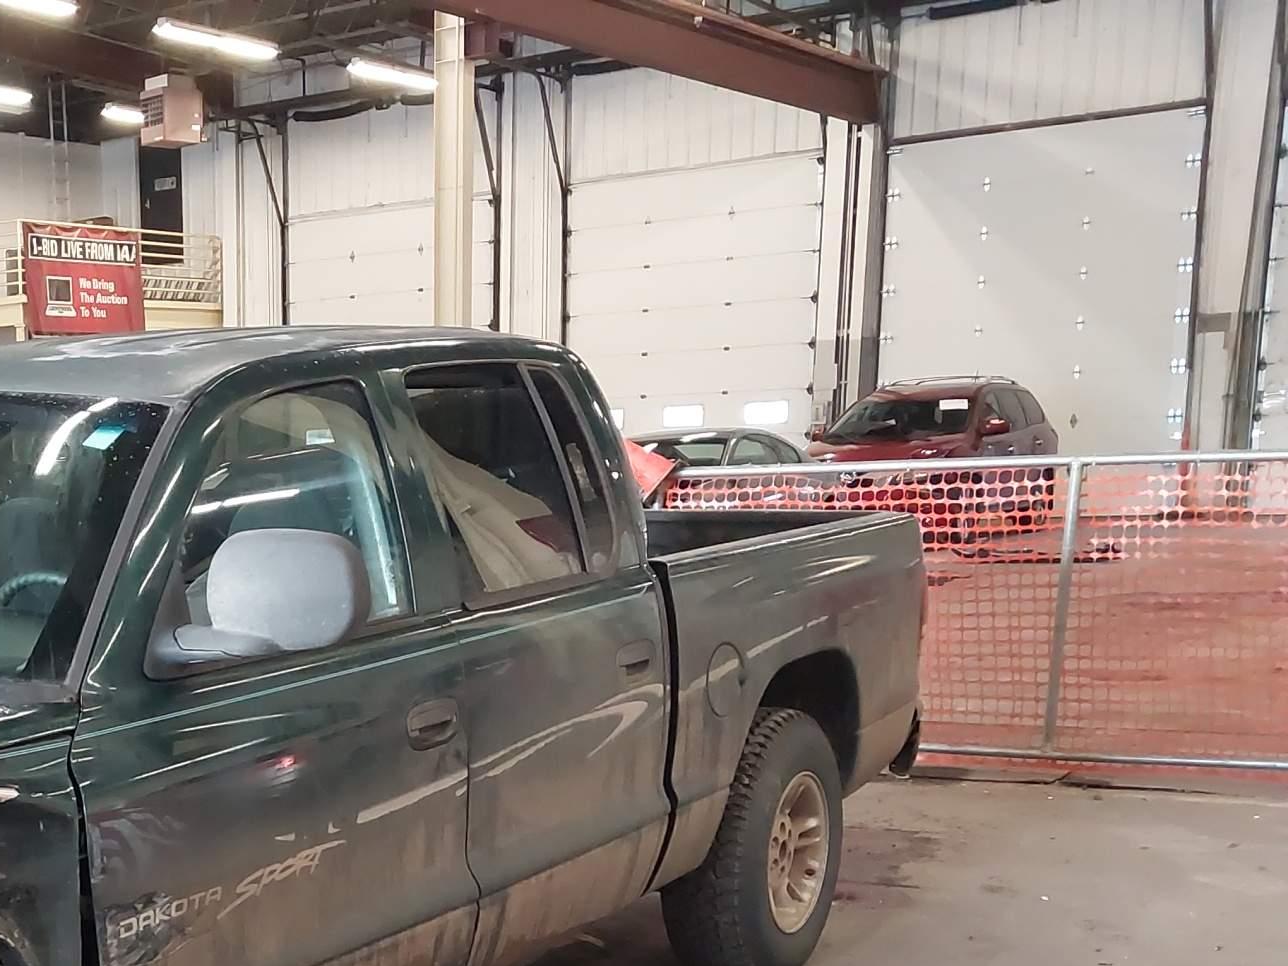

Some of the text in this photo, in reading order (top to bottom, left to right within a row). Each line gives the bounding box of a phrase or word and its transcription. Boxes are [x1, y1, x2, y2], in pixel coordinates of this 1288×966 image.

[61, 240, 83, 259] LIVE
[84, 242, 115, 260] FROM
[79, 277, 114, 293] We Bring
[80, 291, 128, 305] The Auction
[80, 306, 107, 318] To You
[119, 886, 222, 938] DAKOTA
